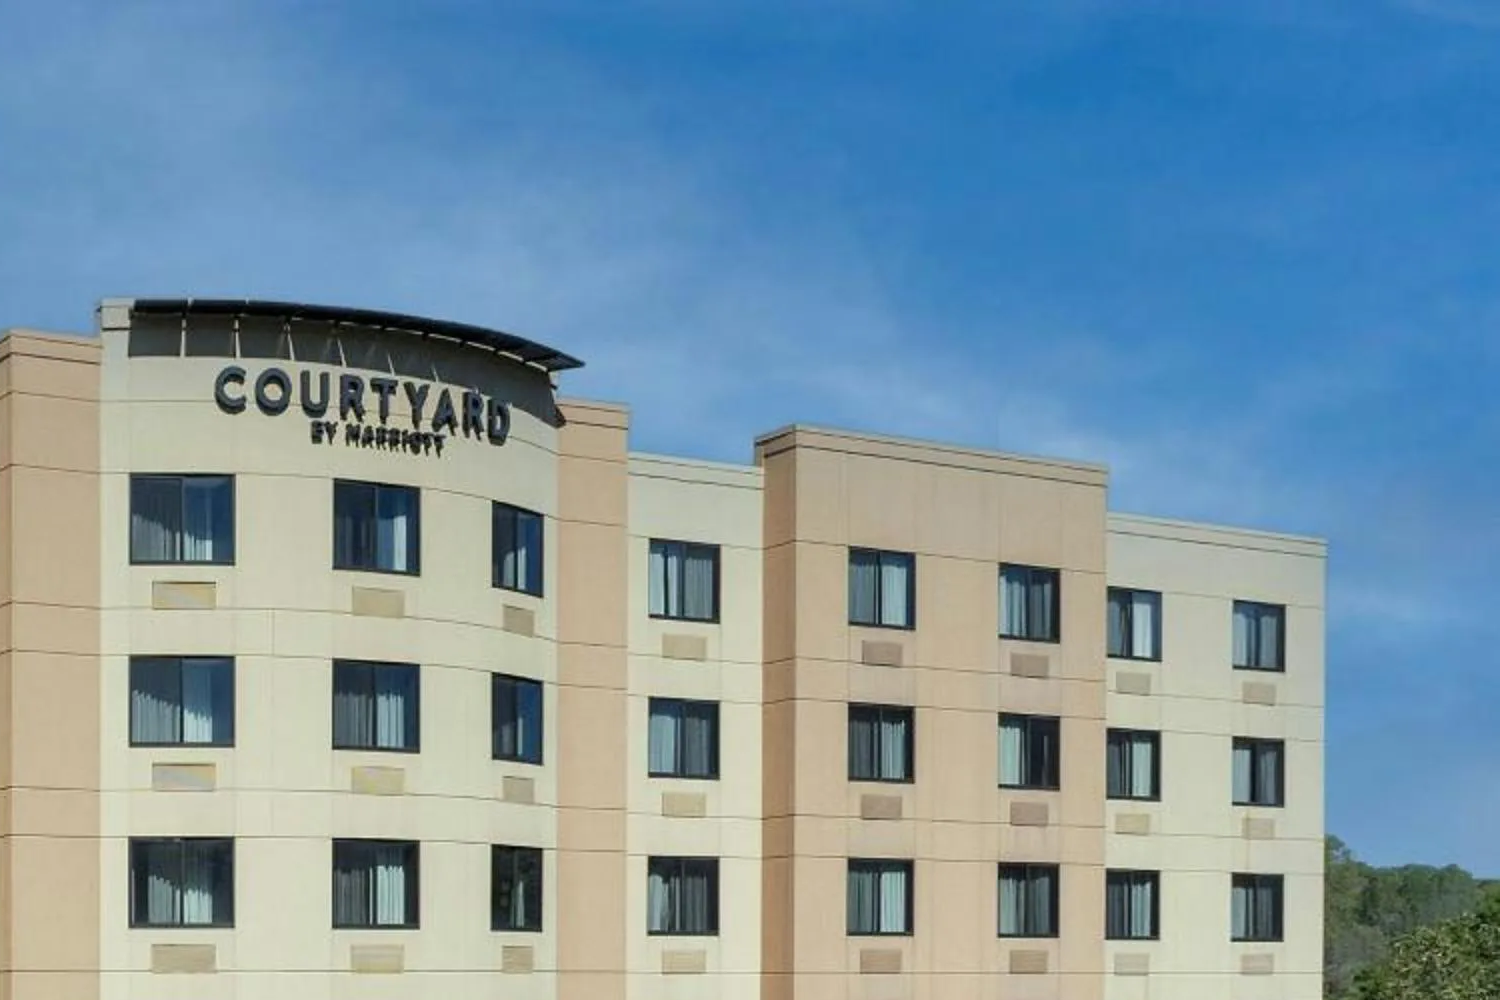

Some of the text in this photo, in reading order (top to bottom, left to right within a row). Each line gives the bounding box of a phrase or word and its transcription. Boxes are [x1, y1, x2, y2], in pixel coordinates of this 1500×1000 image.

[214, 366, 511, 446] COURTYARD
[311, 420, 446, 458] BY MARRIOTT
